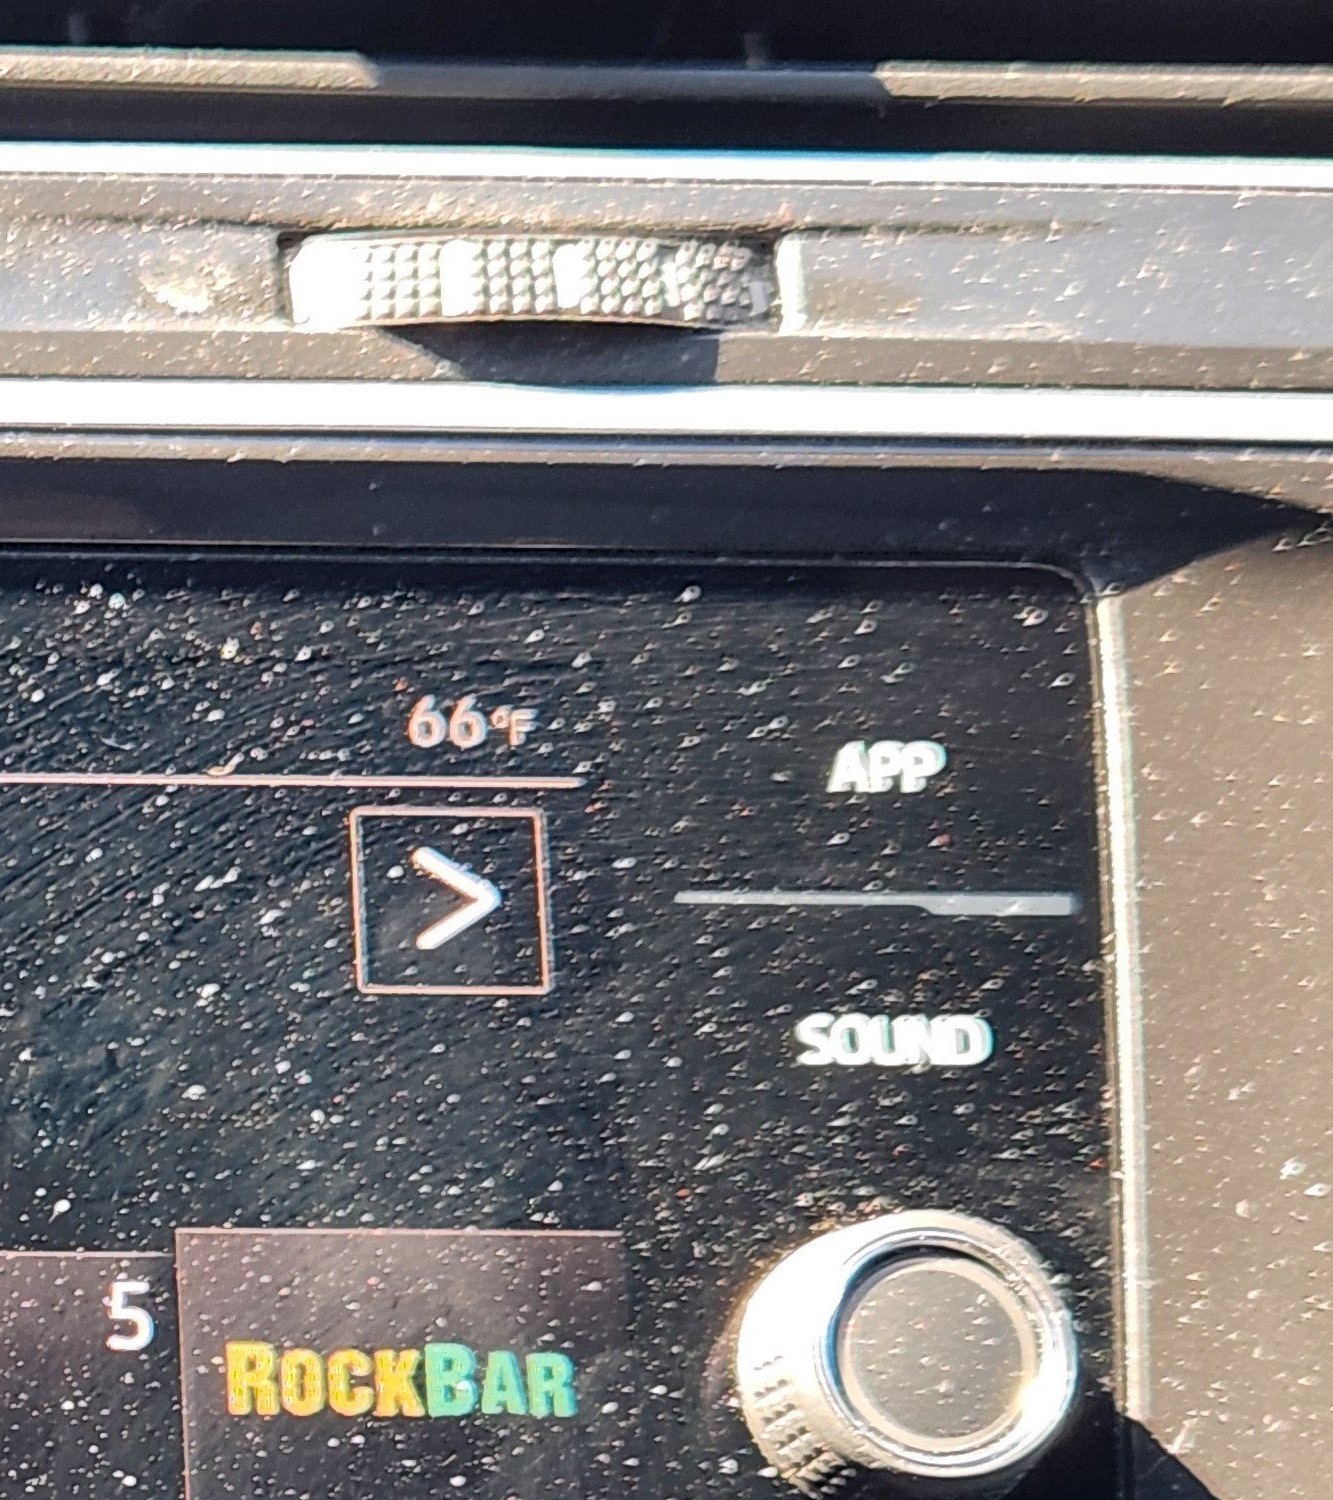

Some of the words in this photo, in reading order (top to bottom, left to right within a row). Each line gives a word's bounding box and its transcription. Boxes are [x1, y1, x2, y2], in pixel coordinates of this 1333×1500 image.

[826, 738, 948, 795] APP
[795, 1012, 995, 1068] SOUND
[105, 1279, 155, 1352] 5
